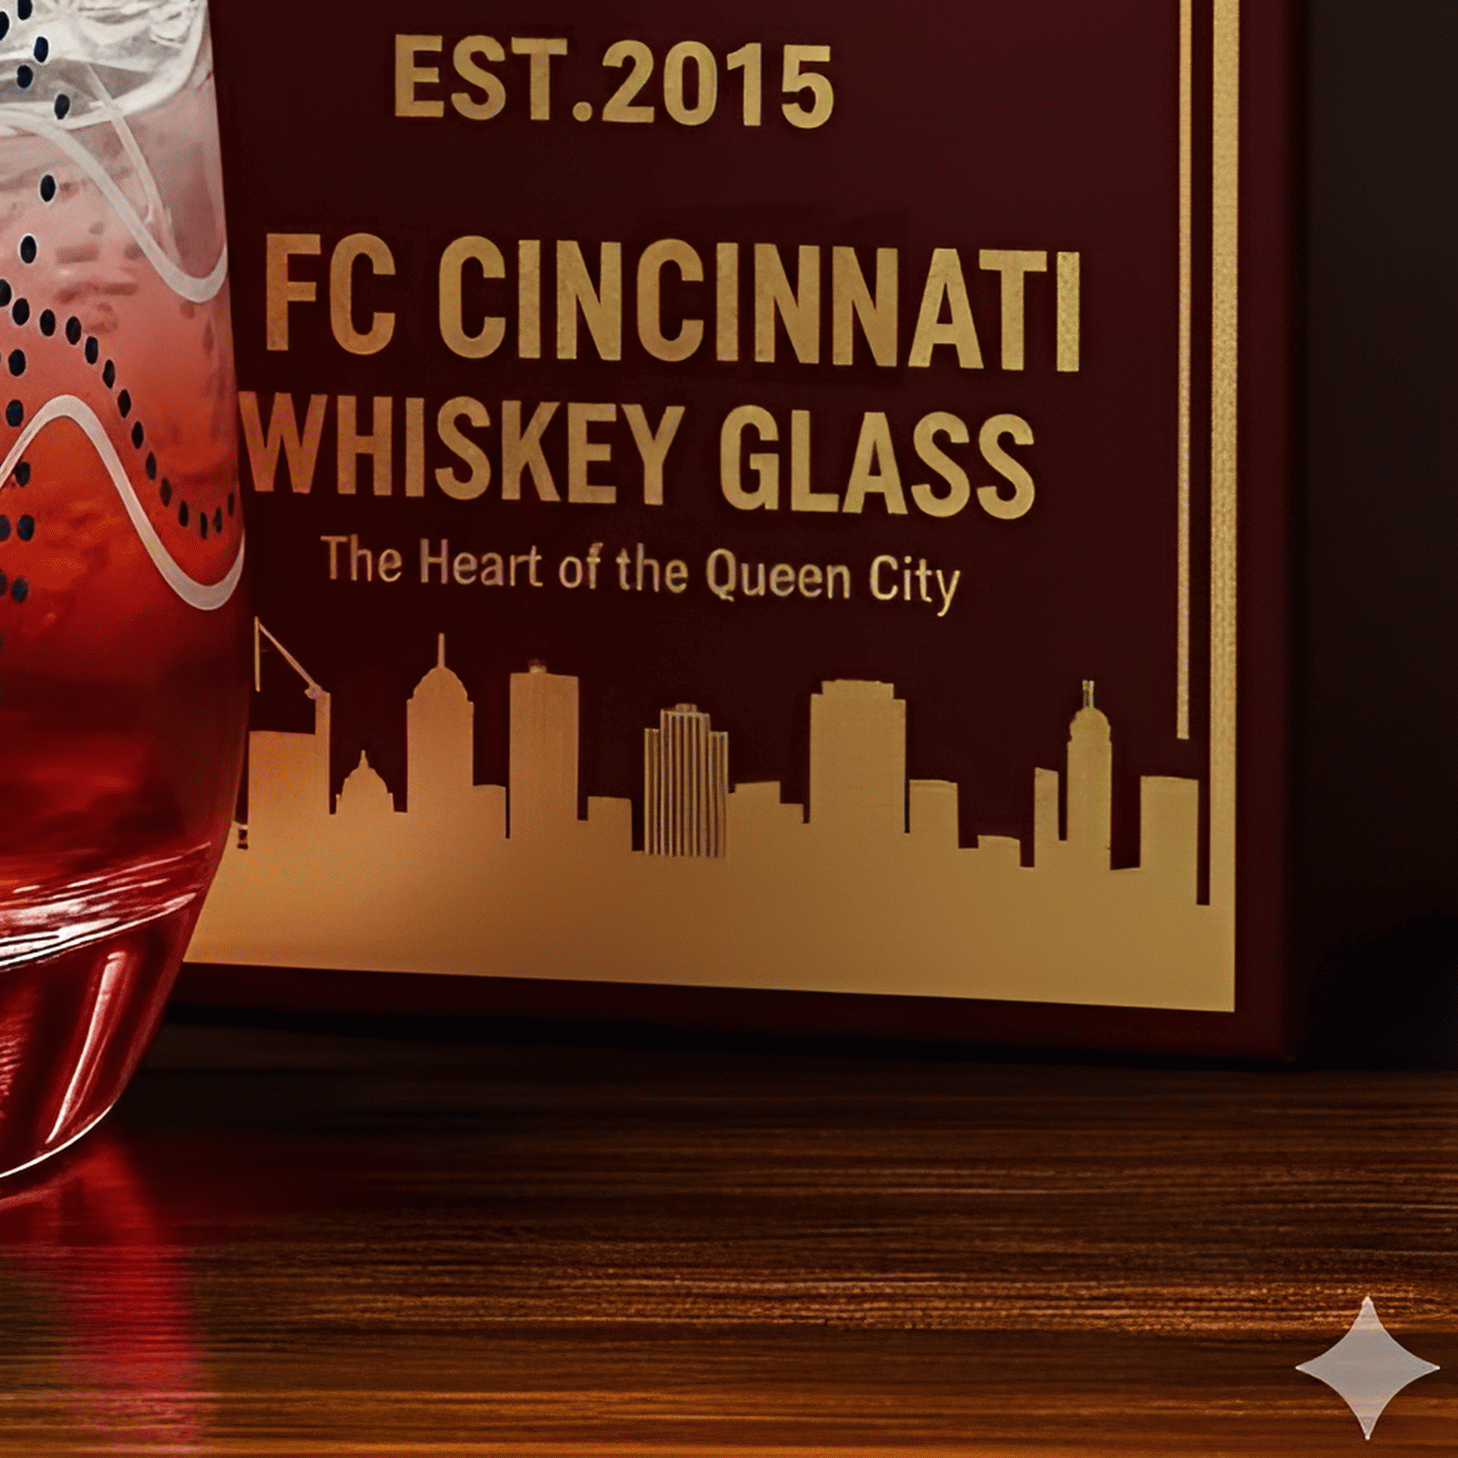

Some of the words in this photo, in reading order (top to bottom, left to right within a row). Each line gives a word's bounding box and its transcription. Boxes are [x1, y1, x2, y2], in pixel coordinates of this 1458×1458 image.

[394, 34, 835, 129] EST.2015
[265, 232, 396, 355] FC
[438, 235, 1082, 372] CINCINNATI
[238, 390, 685, 506] WHISKEY
[719, 405, 1036, 520] GLASS
[321, 535, 402, 583] The
[419, 539, 542, 588] Heart
[559, 543, 603, 590] of
[615, 546, 688, 593] the
[706, 548, 851, 602] Queen
[869, 554, 962, 617] City
